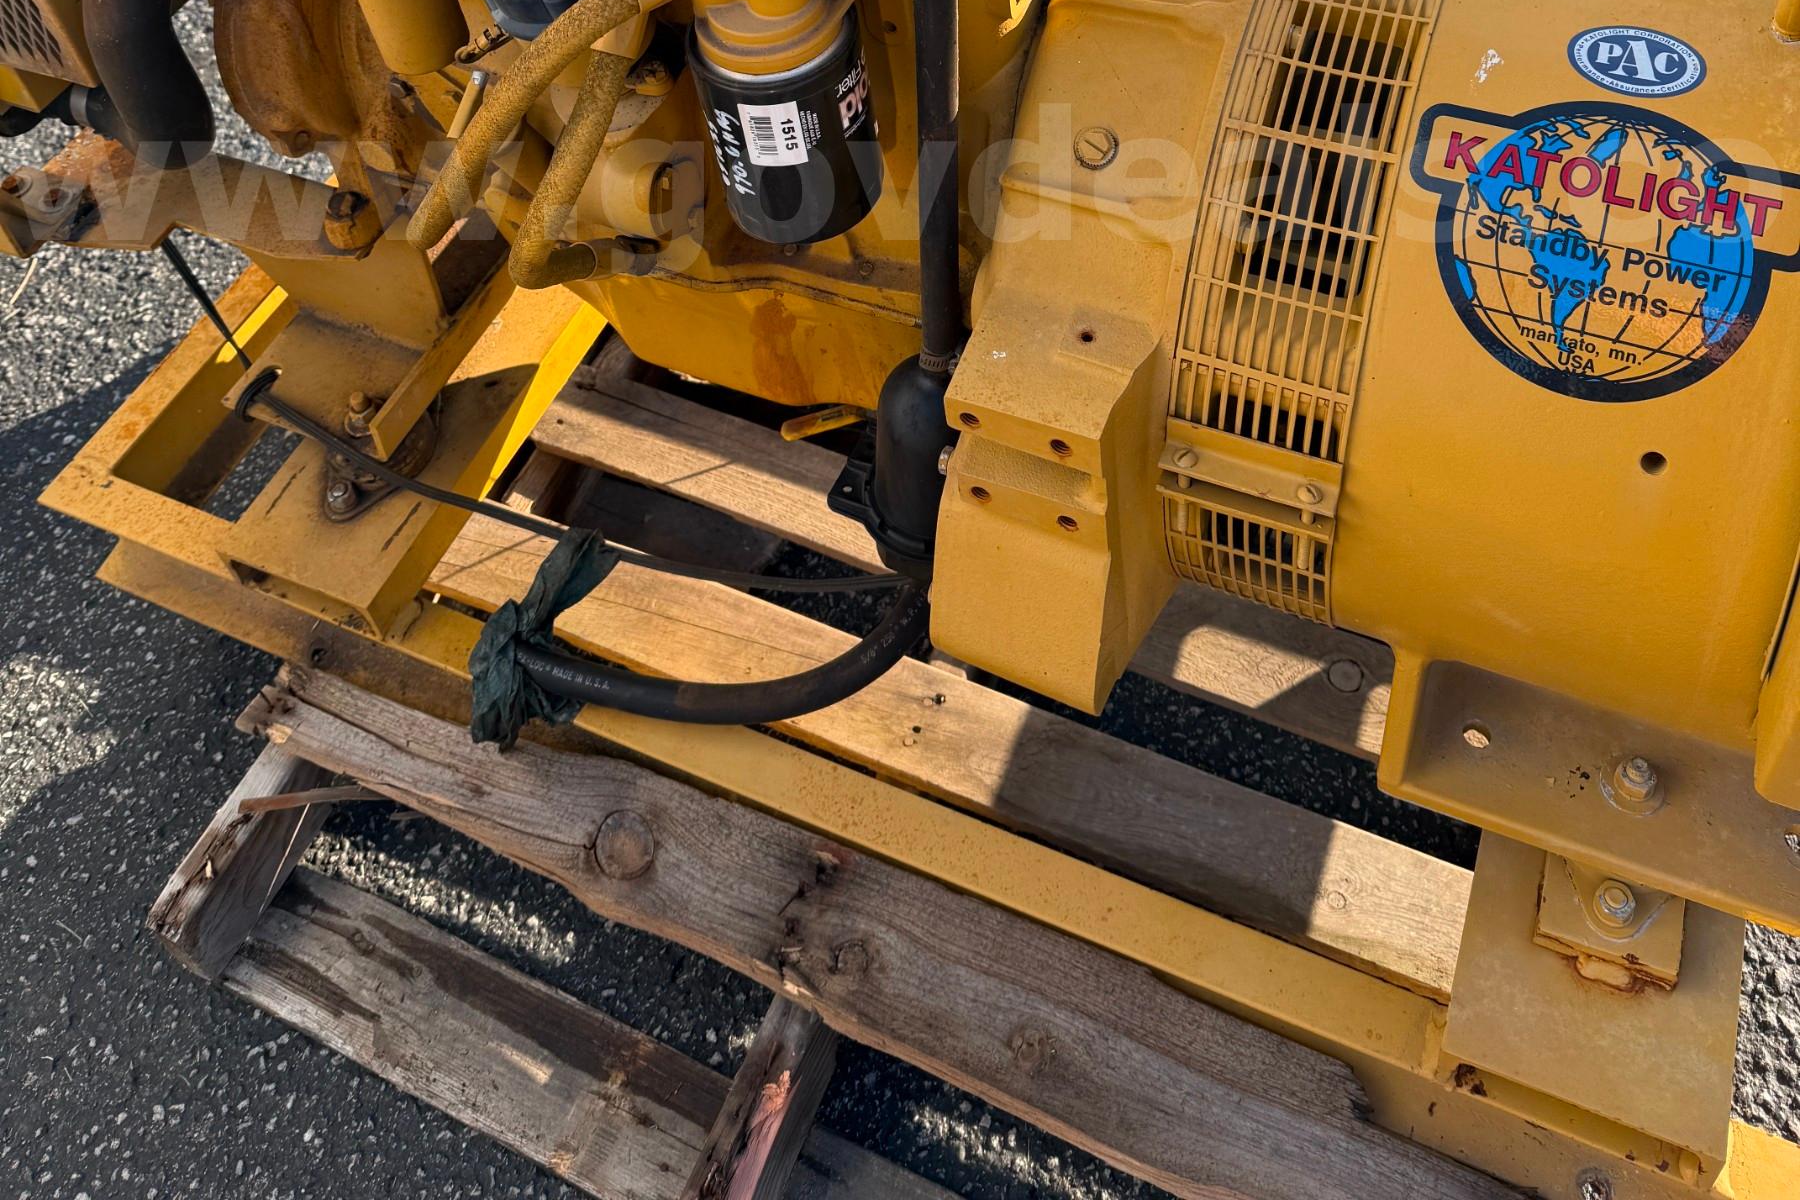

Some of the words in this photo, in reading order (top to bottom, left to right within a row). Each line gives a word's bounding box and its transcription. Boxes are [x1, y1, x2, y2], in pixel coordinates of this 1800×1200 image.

[1584, 29, 1630, 43] KATOLIGHT
[1634, 30, 1694, 58] CORPORATION
[1595, 40, 1679, 82] PAC
[839, 71, 869, 131] old
[1610, 80, 1656, 94] Assurance
[781, 118, 799, 151] 1515
[1444, 131, 1783, 237] KATOLIGHT
[1475, 214, 1609, 272] Standby
[1622, 248, 1727, 293] Power
[1527, 263, 1668, 318] Systems
[1520, 325, 1600, 357] mankato,
[1608, 347, 1642, 366] mn.
[1558, 351, 1595, 373] USA
[552, 666, 573, 681] MADE
[575, 673, 583, 682] IN
[585, 679, 611, 690] U.S.A.
